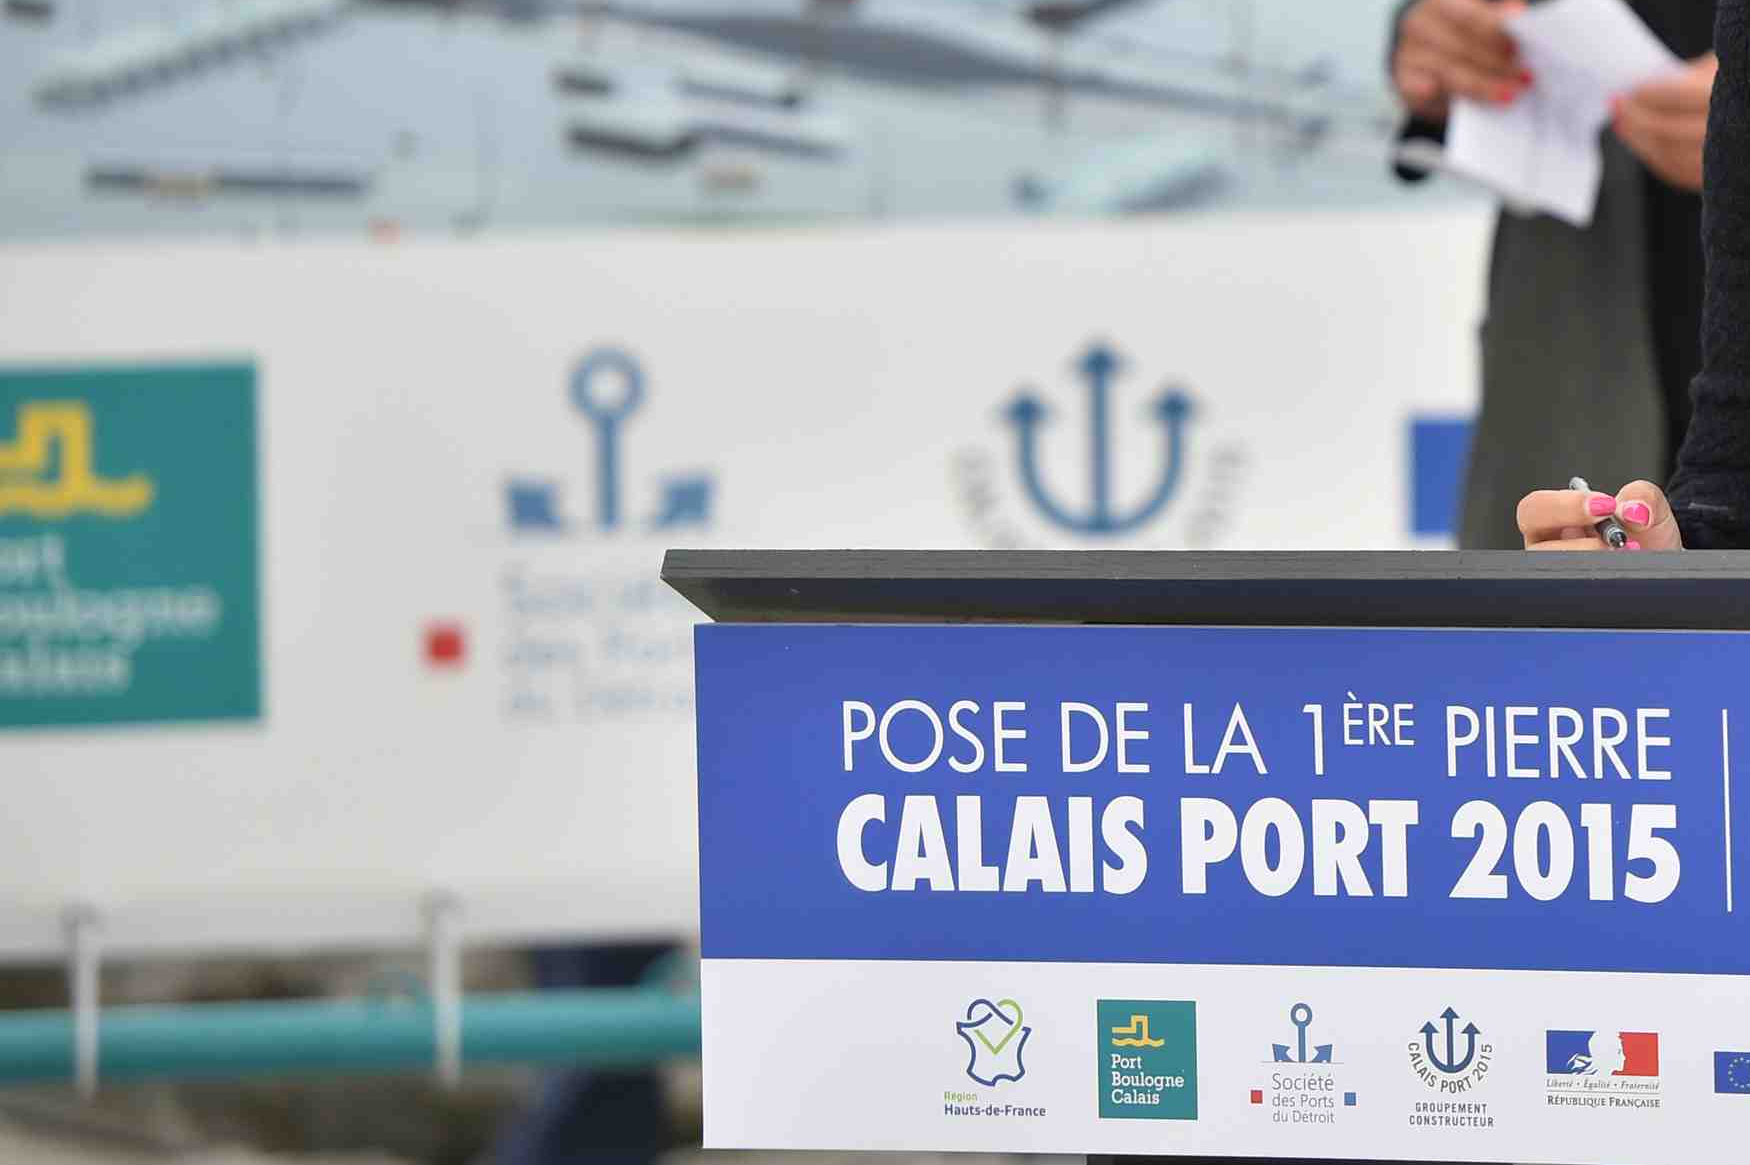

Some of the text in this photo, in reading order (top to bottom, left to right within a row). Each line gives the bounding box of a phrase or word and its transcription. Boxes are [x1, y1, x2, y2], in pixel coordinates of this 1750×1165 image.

[841, 691, 1673, 781] POSE DE LA 1ÈRE PIERRE
[836, 792, 1682, 904] CALAIS PORT 2015
[1111, 1053, 1142, 1069] Port
[1408, 1042, 1493, 1094] CALAIS PORT 2015
[1111, 1071, 1185, 1091] Boulogne
[1272, 1072, 1334, 1091] Société
[943, 1091, 978, 1102] Région
[1111, 1088, 1160, 1105] Calais
[1272, 1093, 1335, 1109] des Ports
[944, 1103, 1047, 1117] Hauts-de-France
[1415, 1102, 1488, 1114] GROUPEMENT
[1272, 1109, 1336, 1124] du Détroit
[1409, 1115, 1495, 1127] CONSTRUCTEUR
